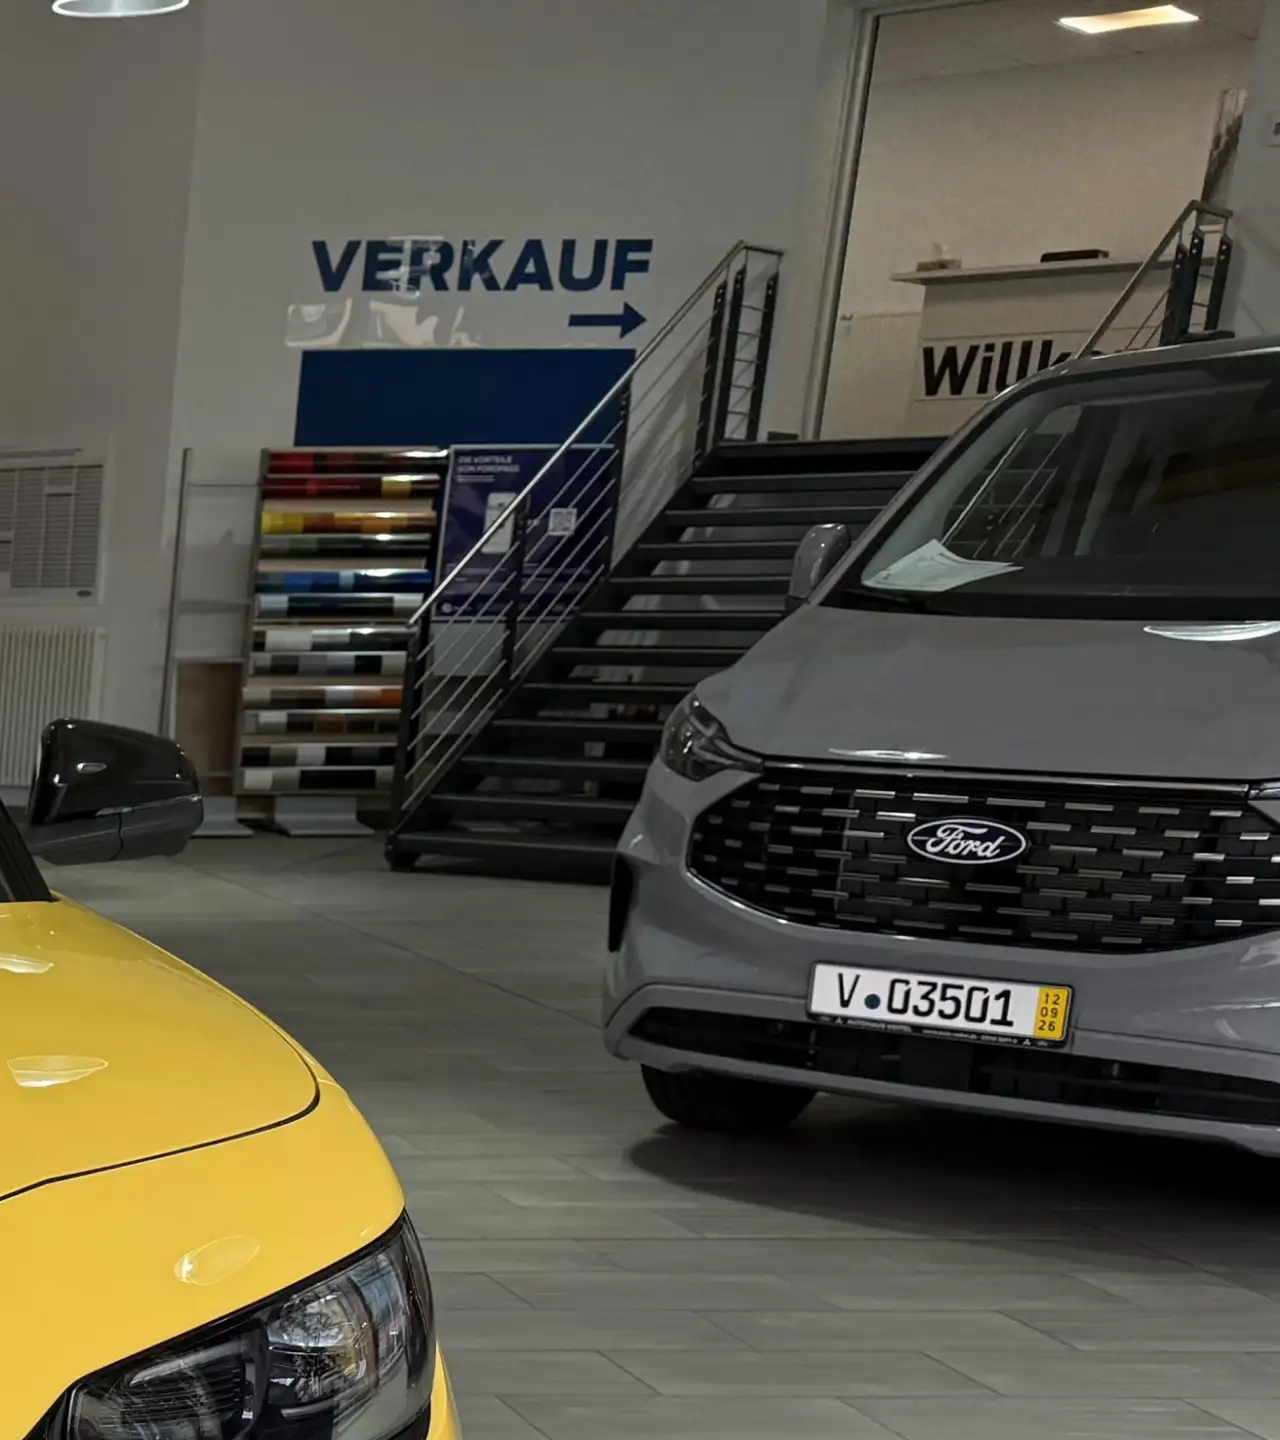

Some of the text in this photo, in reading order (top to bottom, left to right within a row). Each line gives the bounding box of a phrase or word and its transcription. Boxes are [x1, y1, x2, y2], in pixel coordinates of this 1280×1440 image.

[311, 239, 653, 292] VERKAUF
[923, 339, 1102, 397] Willk
[926, 824, 1006, 858] Ford
[838, 972, 1014, 1027] V 03501
[1040, 1006, 1058, 1019] 09
[1044, 992, 1060, 1005] 12
[1038, 1019, 1056, 1032] 26
